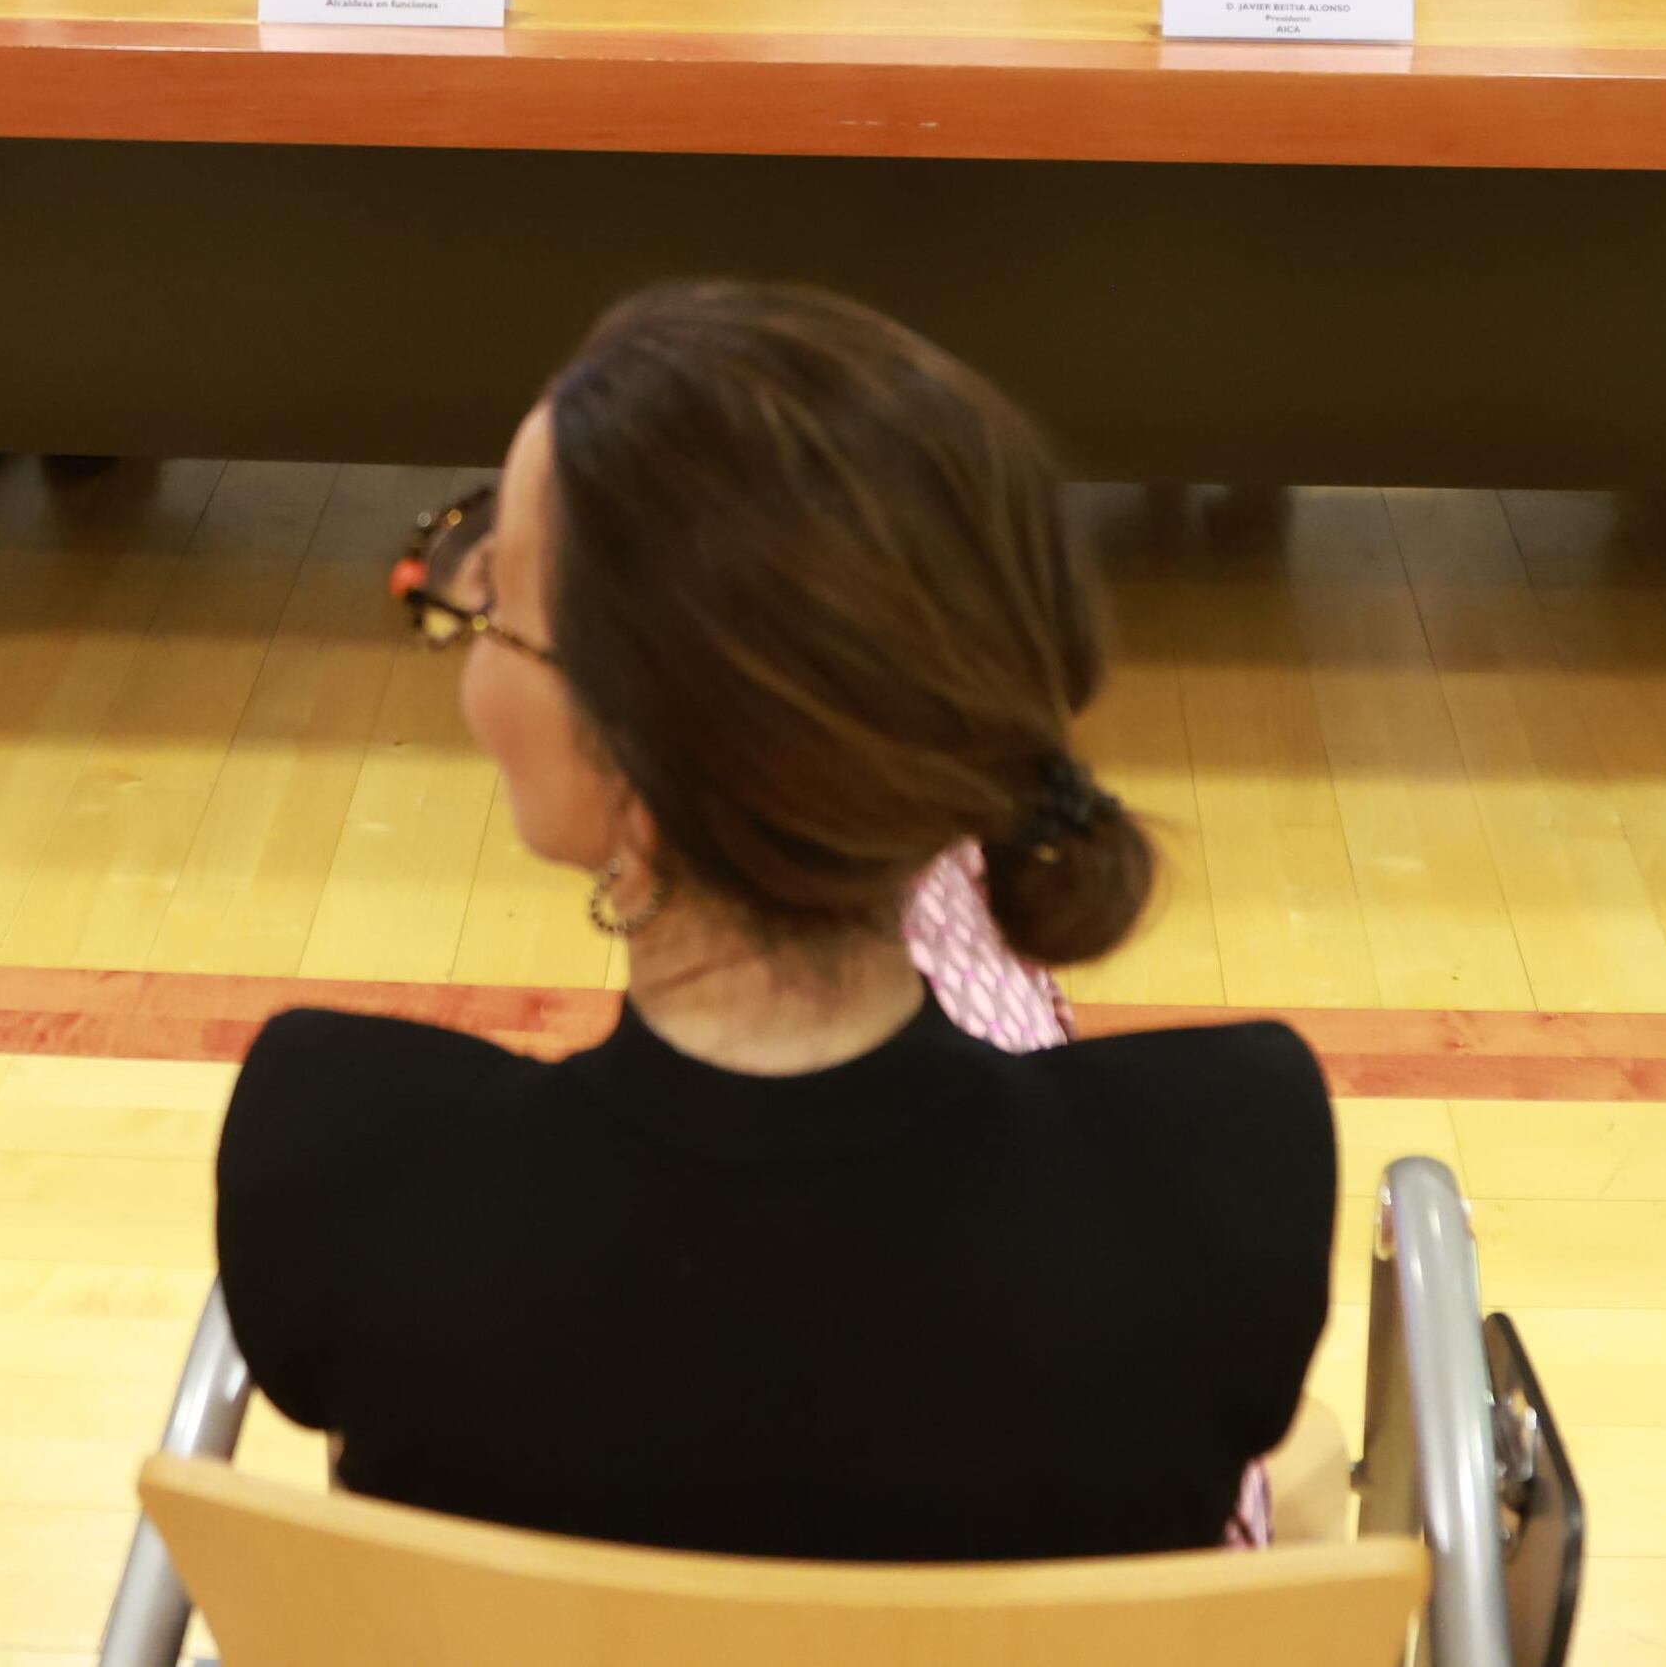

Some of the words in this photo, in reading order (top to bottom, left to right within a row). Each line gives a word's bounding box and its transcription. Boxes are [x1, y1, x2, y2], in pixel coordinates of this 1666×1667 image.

[376, 0, 388, 8] en
[390, 0, 439, 9] funciones
[1238, 3, 1271, 12] JAVIER
[1308, 4, 1351, 13] ALONSO
[1265, 14, 1311, 23] Presidente
[1276, 25, 1301, 34] AICA
